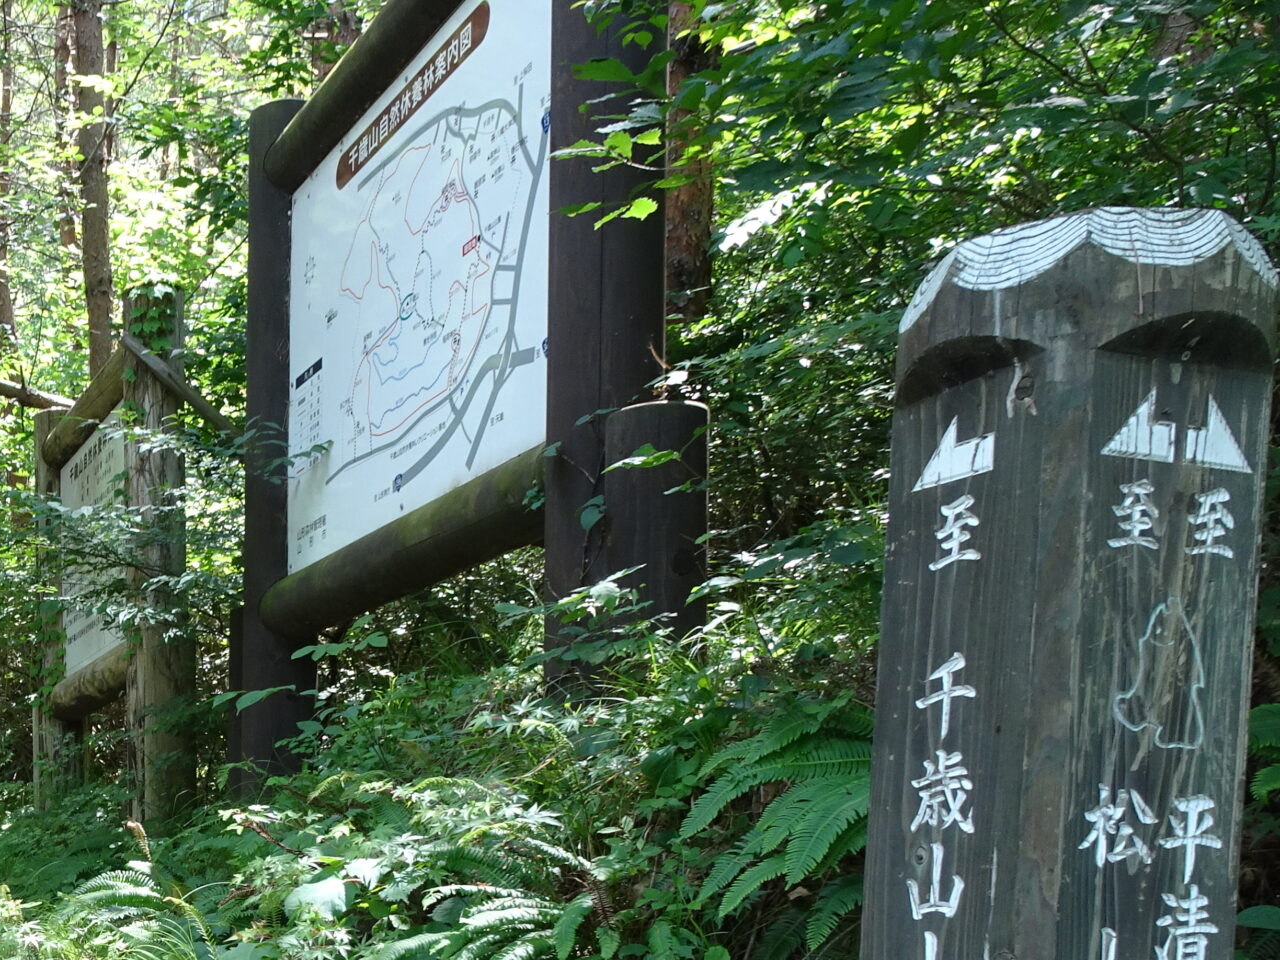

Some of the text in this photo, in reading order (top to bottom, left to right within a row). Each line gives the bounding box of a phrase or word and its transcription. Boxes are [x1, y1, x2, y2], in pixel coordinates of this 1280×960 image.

[348, 22, 472, 172] 千歳山自然休養林案内図
[928, 493, 981, 571] 至
[1106, 478, 1160, 550] 至
[1183, 486, 1235, 559] 至
